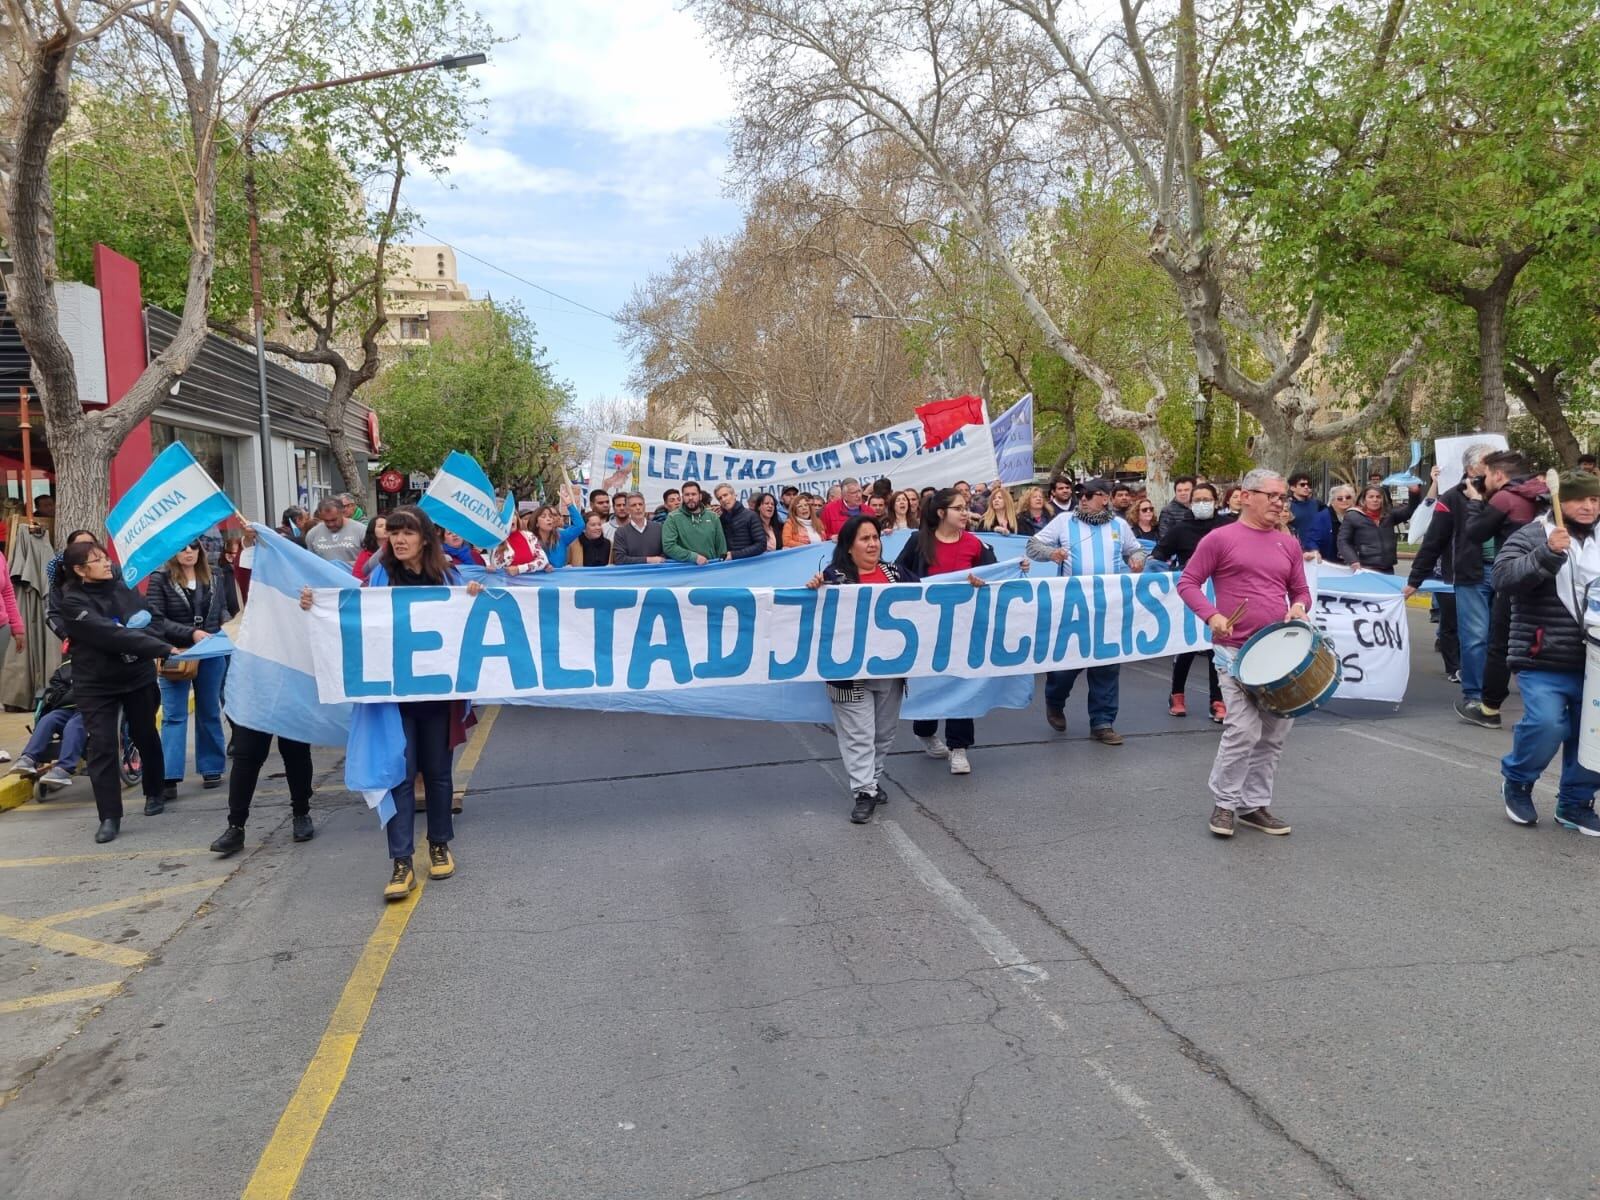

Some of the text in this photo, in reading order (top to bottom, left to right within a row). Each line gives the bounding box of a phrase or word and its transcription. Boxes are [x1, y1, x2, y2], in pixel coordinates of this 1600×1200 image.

[647, 445, 777, 481] LEALTAD
[849, 427, 966, 464] CRISTA
[123, 489, 188, 546] ARGENTINA
[338, 587, 757, 698] LEALTAD
[1353, 619, 1403, 650] CON
